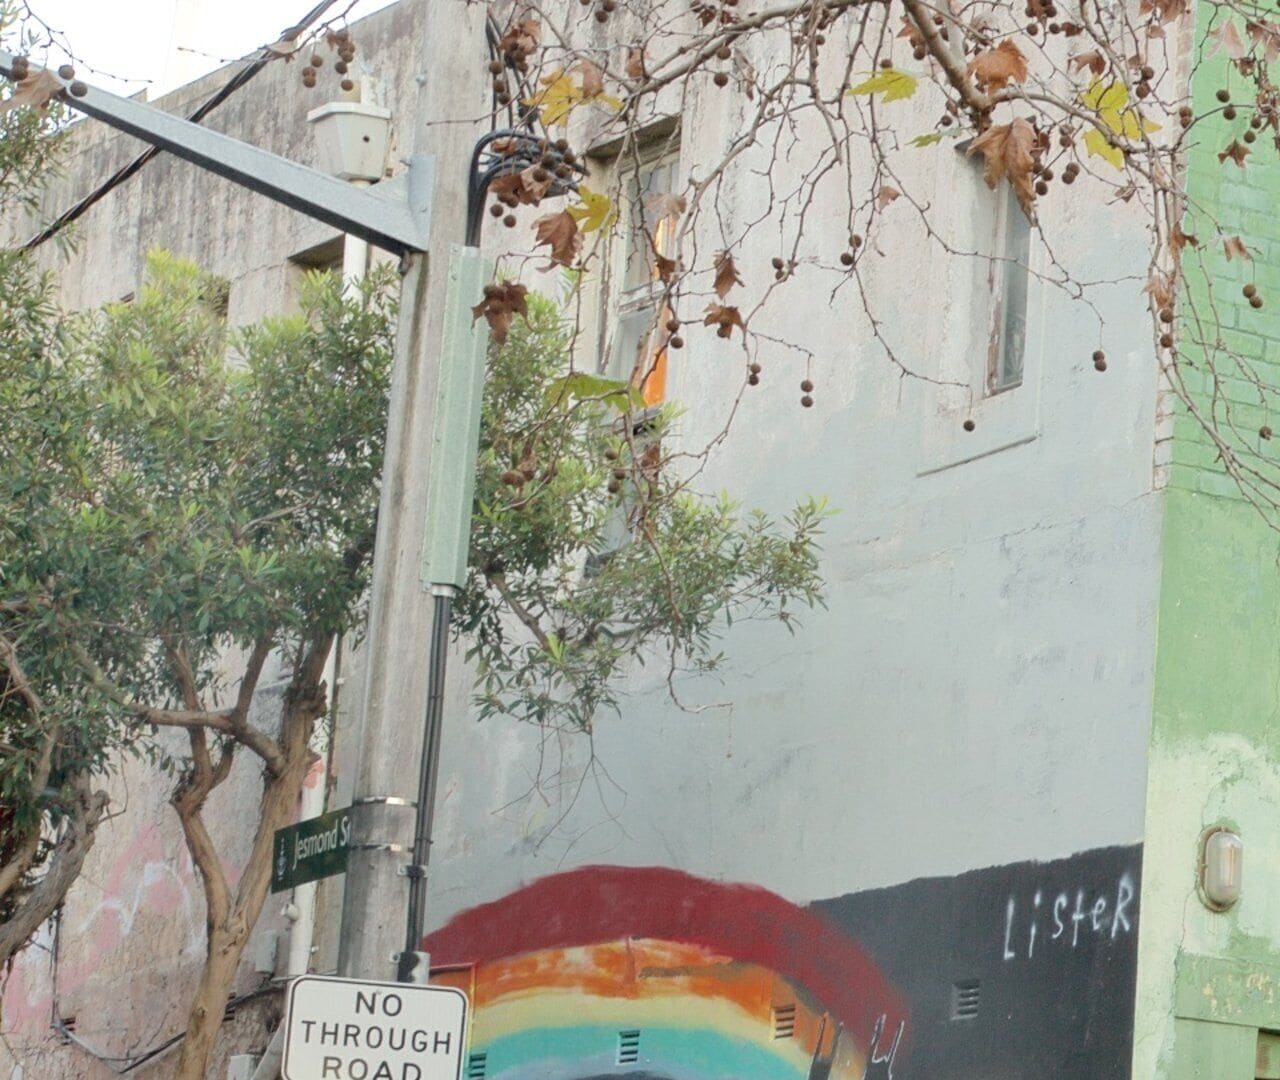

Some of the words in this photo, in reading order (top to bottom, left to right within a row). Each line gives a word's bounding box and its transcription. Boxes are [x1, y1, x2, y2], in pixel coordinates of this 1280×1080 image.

[292, 818, 339, 871] Jesmond
[355, 991, 403, 1017] NO
[302, 1019, 452, 1055] THROUGH
